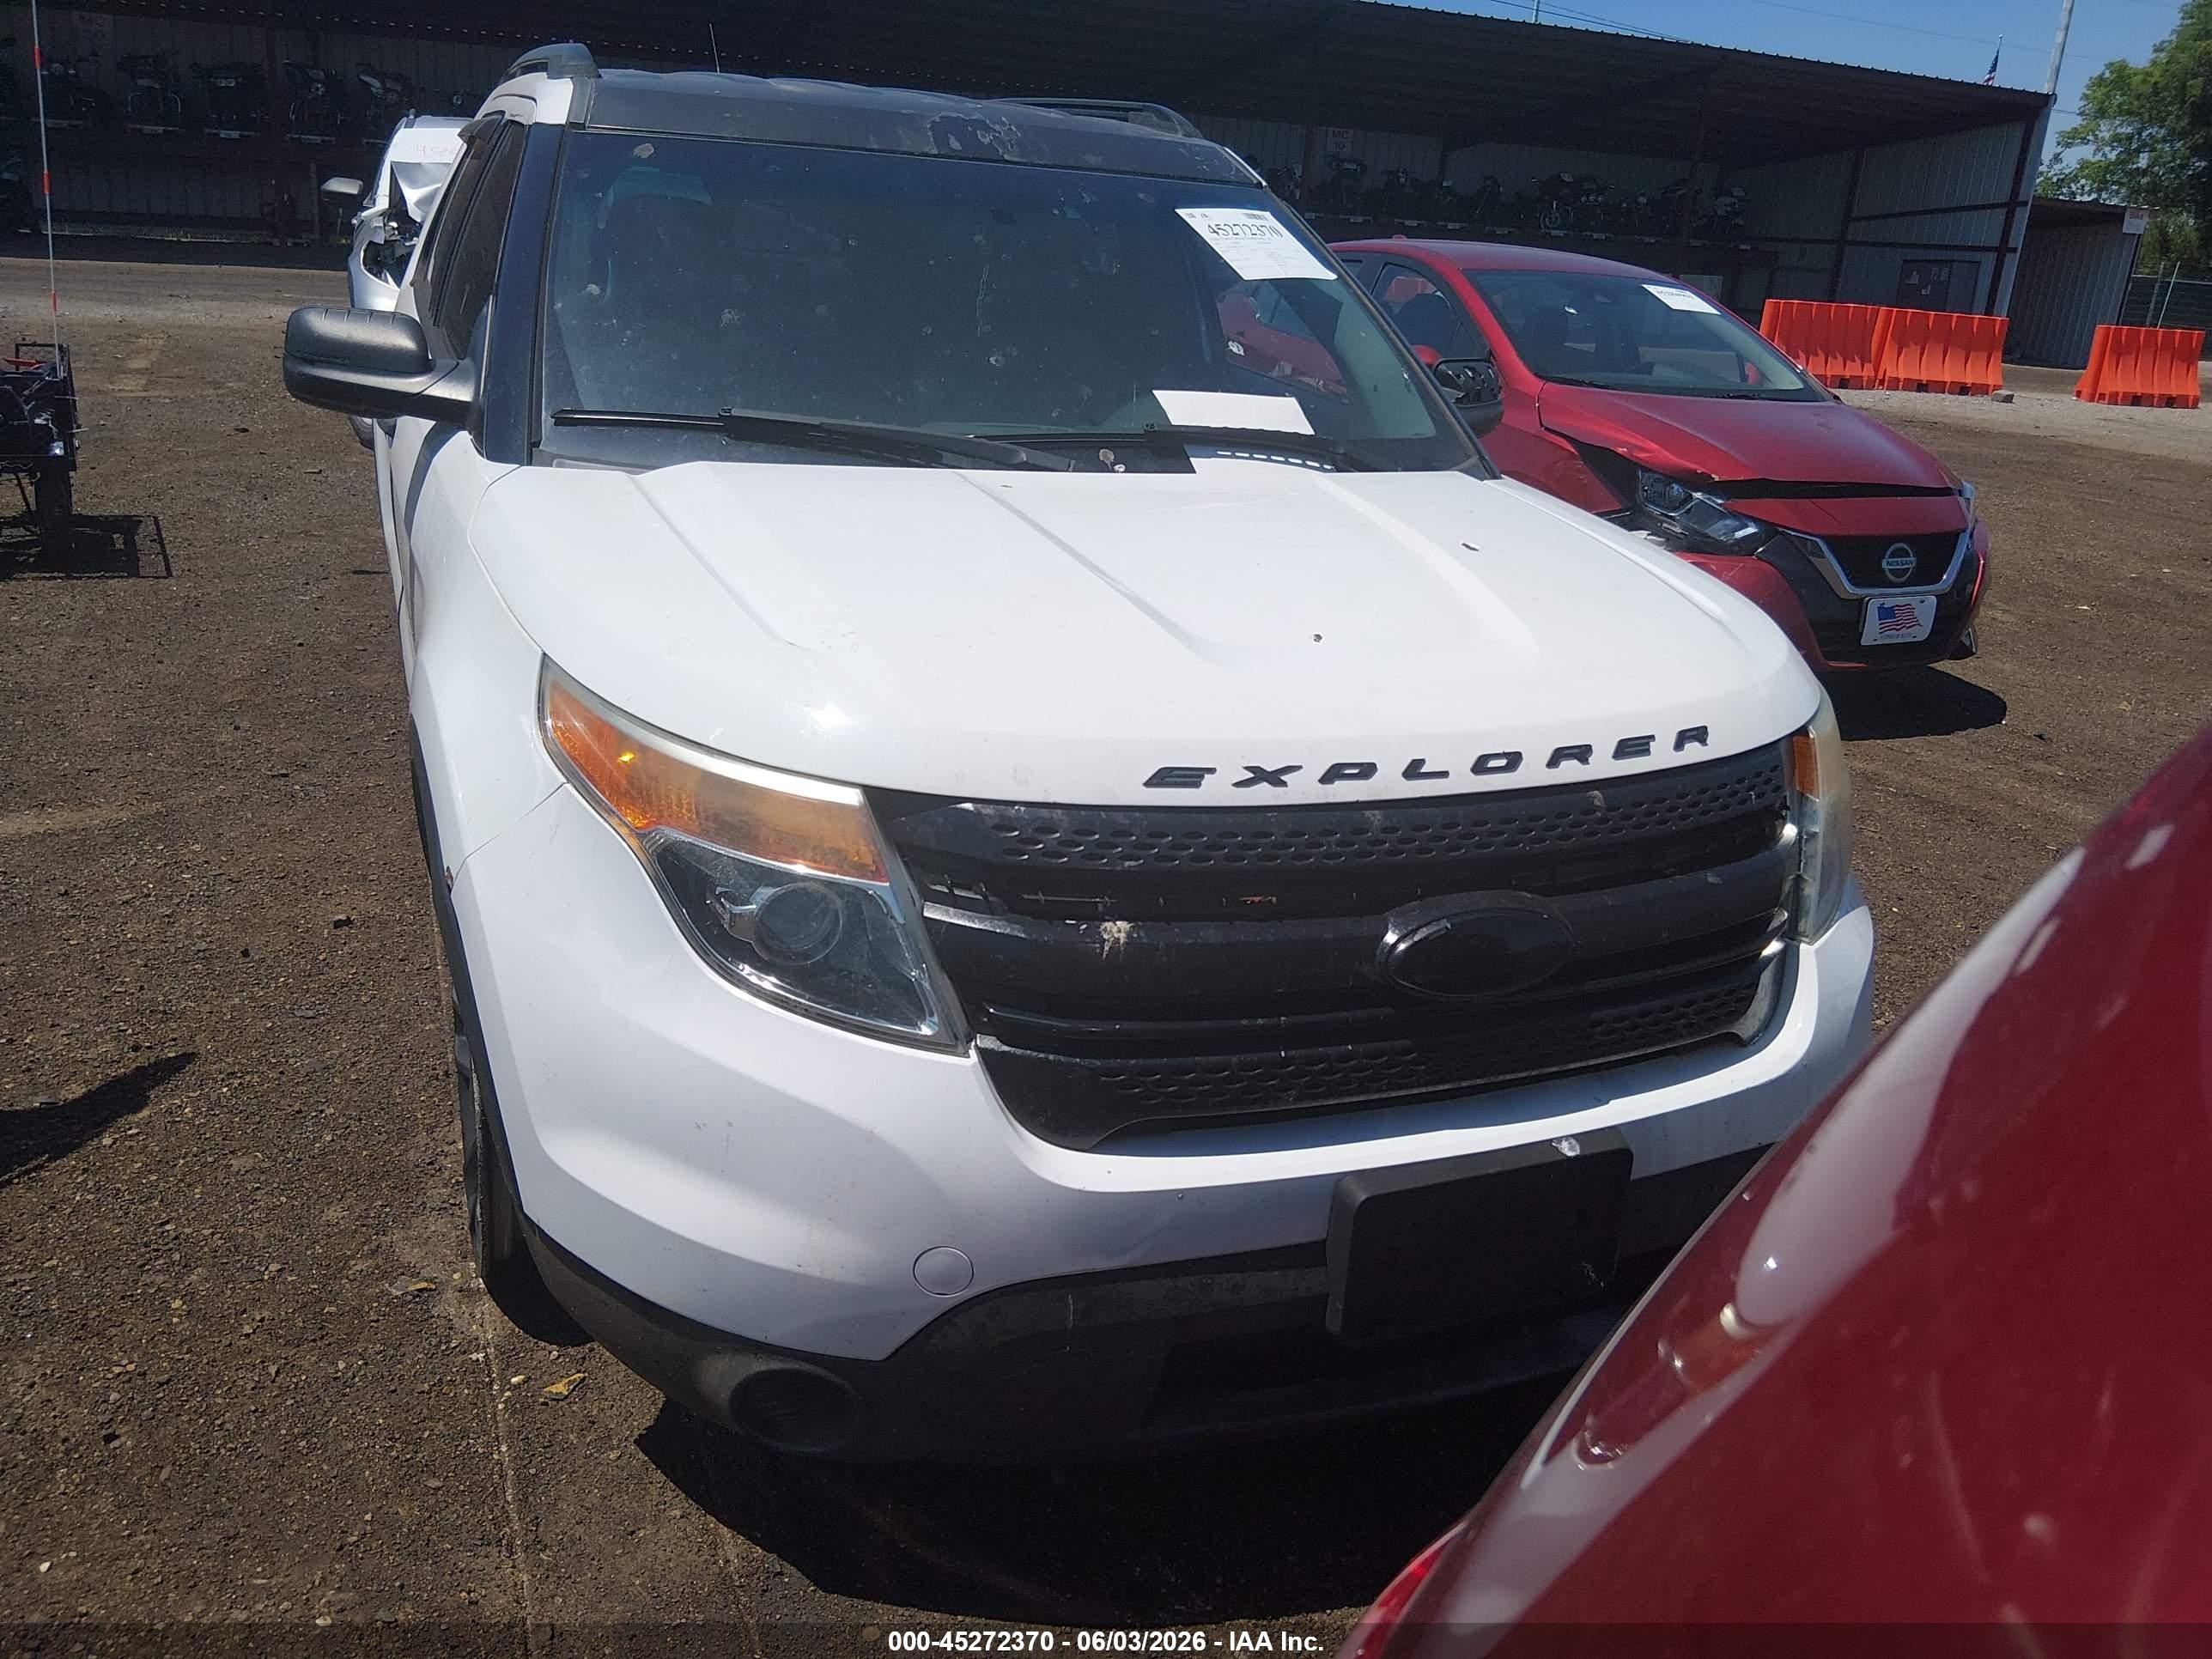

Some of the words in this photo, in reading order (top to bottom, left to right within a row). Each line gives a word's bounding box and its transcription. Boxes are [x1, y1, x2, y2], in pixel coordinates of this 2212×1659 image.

[1333, 130, 1349, 139] MC
[1207, 223, 1284, 238] 45272370
[1886, 559, 1914, 568] NISSAN
[1143, 725, 1710, 789] EXPLORER
